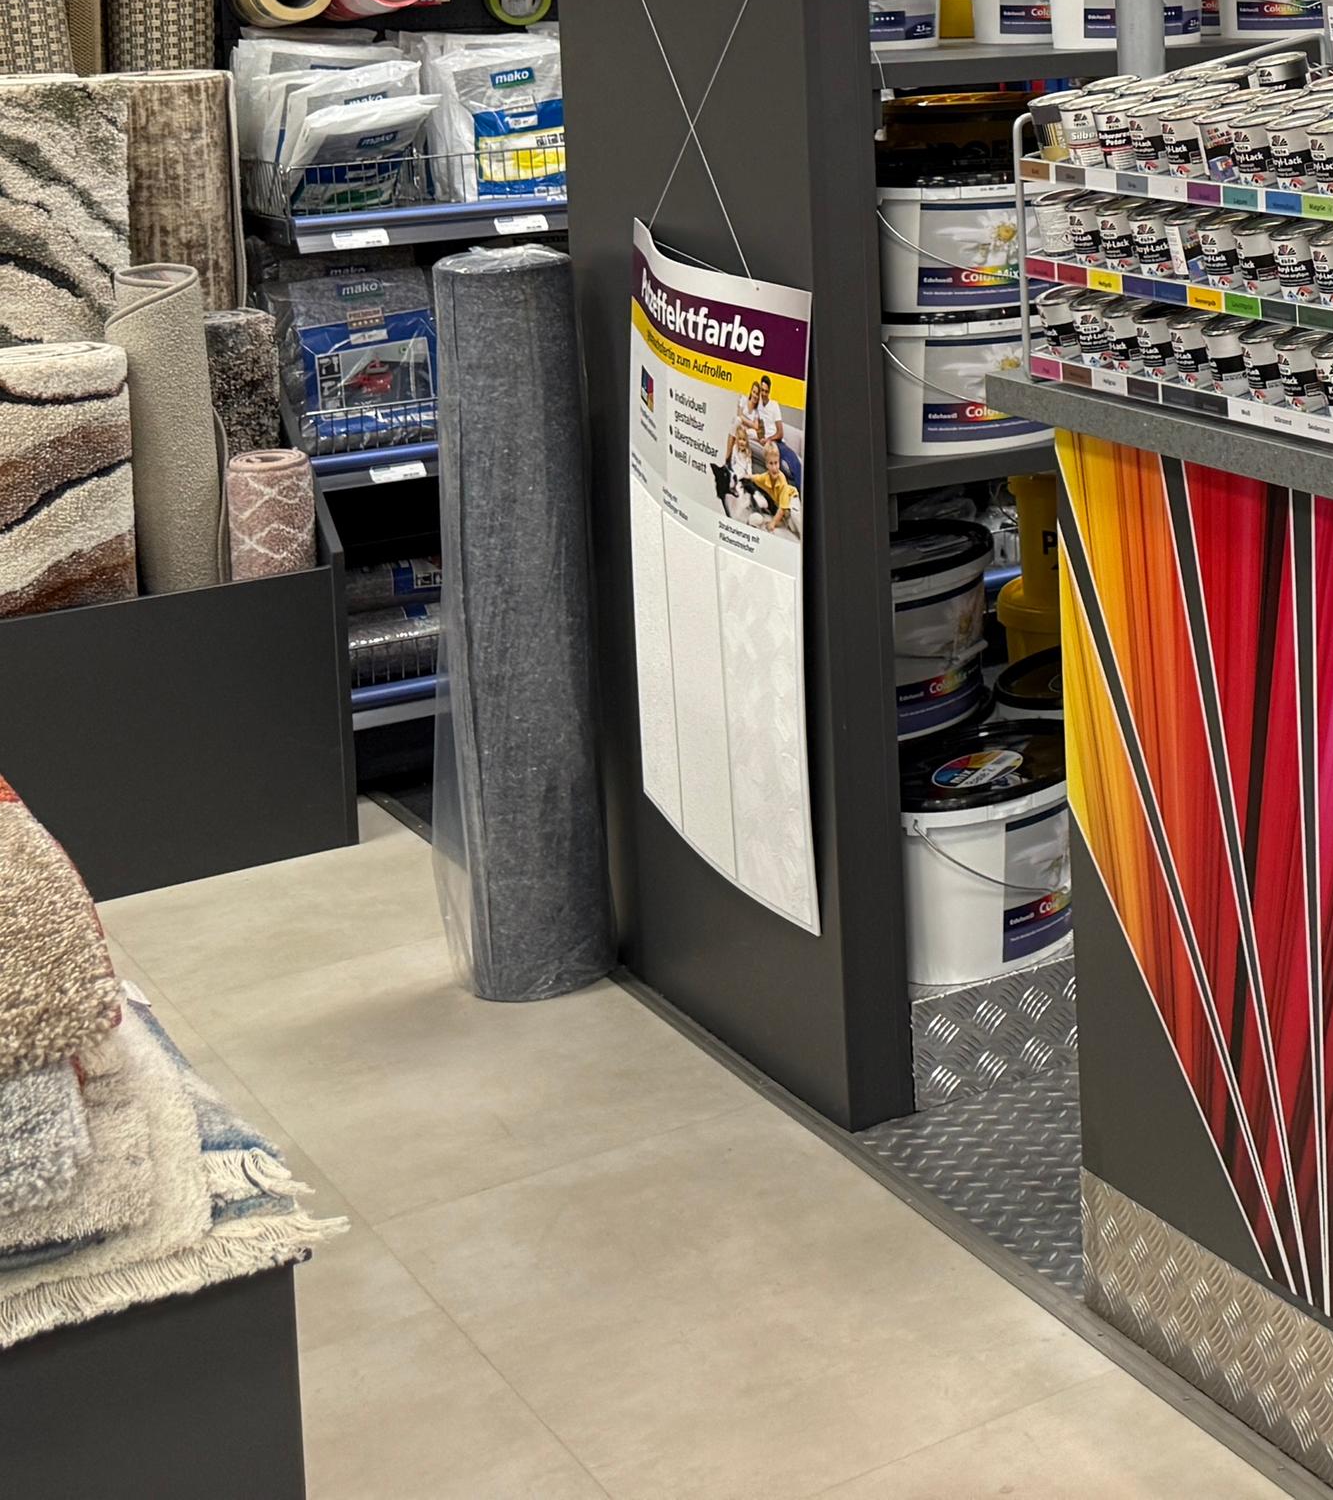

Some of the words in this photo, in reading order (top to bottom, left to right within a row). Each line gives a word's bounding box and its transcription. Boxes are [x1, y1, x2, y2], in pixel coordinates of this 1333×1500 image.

[495, 70, 531, 85] mako
[361, 133, 394, 147] mako
[341, 280, 379, 295] mako
[692, 359, 732, 382] Aufrollen
[674, 391, 706, 414] individuell
